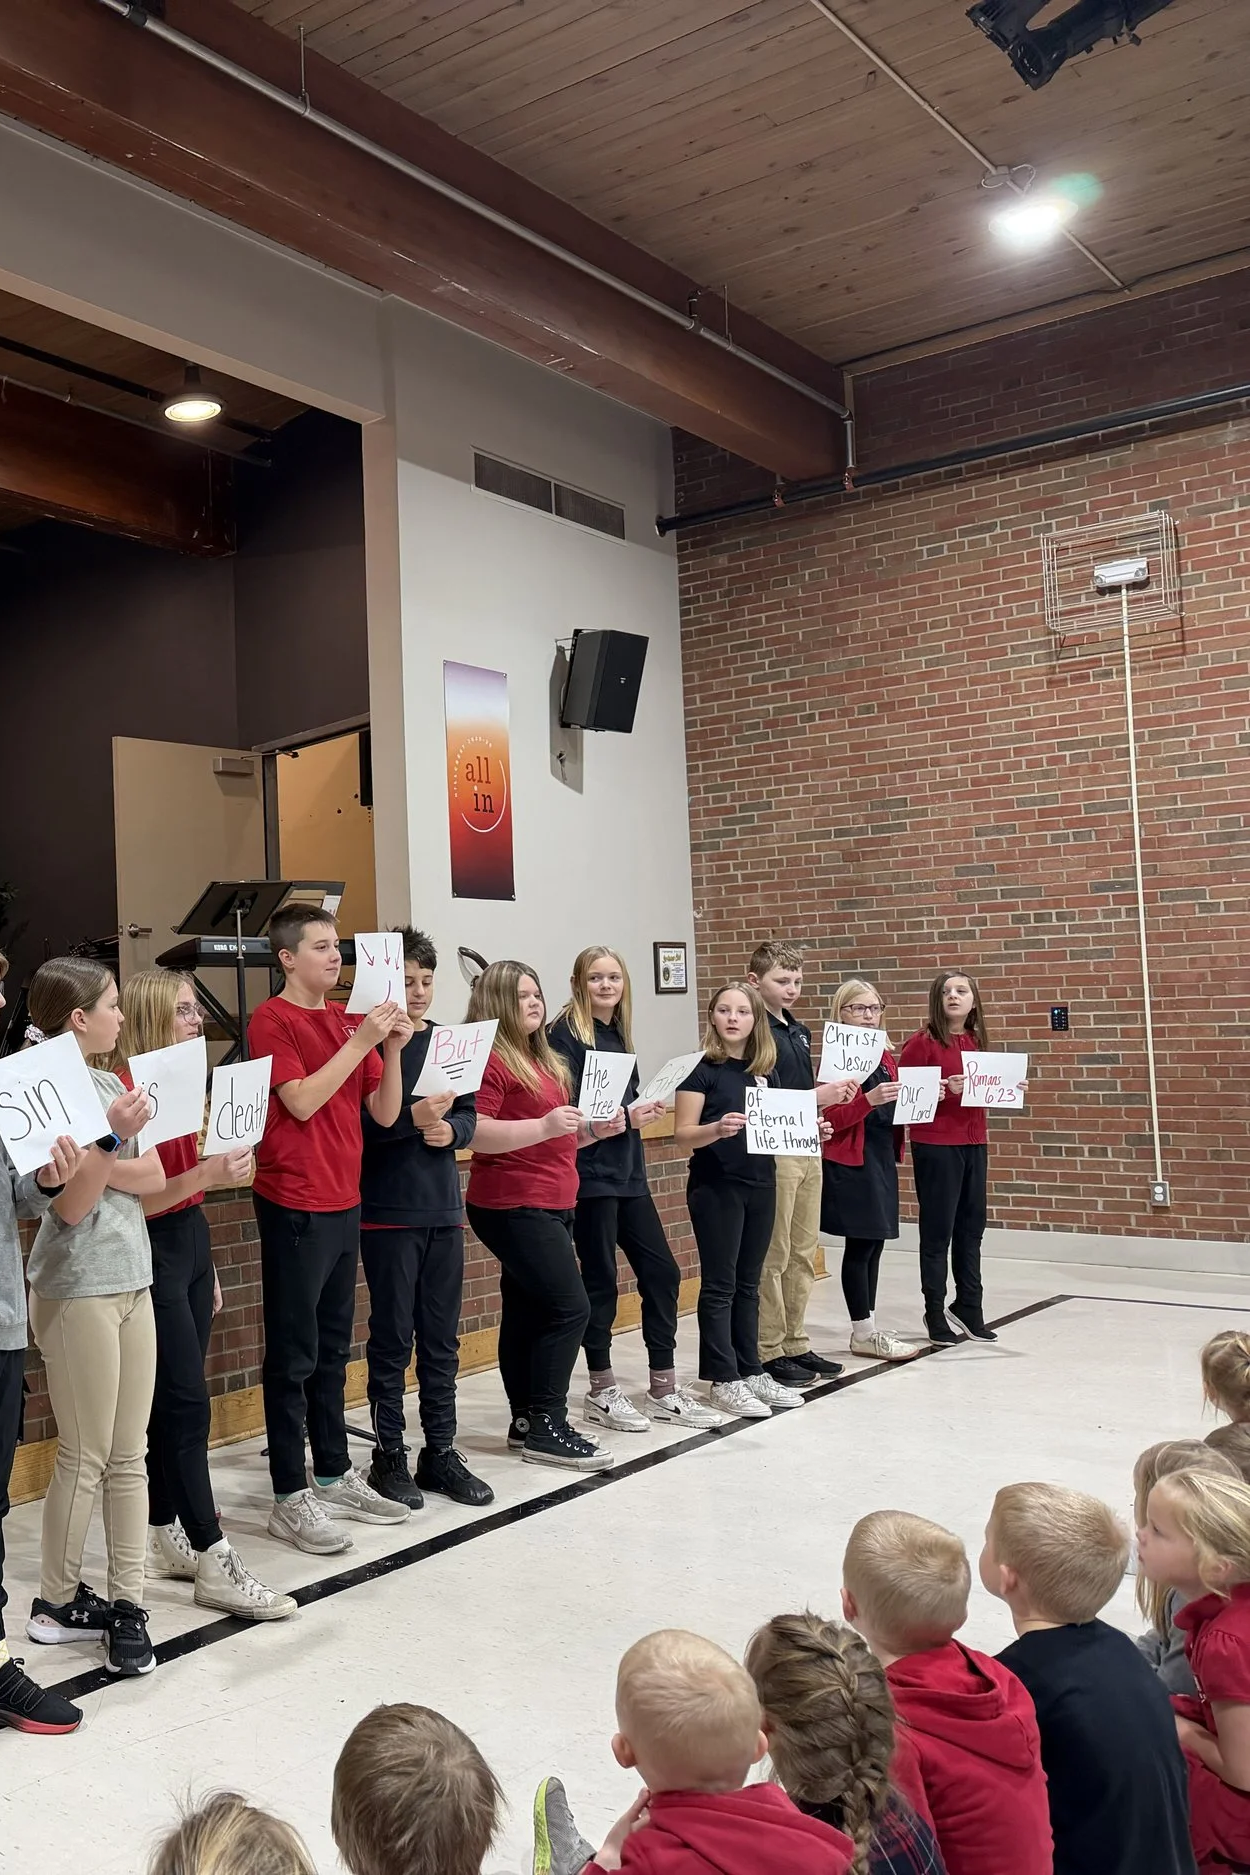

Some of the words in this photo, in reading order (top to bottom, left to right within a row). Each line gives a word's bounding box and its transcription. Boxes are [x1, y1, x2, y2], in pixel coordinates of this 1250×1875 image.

[465, 755, 492, 785] all
[473, 785, 495, 814] in
[431, 1029, 484, 1065] But
[825, 1024, 878, 1047] Christ
[585, 1055, 610, 1090] the
[833, 1048, 873, 1073] Jesus
[966, 1060, 1002, 1098] Romans
[141, 1081, 159, 1120] s
[216, 1077, 267, 1141] death
[590, 1089, 615, 1116] free
[911, 1103, 933, 1122] Lord
[748, 1109, 804, 1128] eternal
[754, 1129, 779, 1150] life
